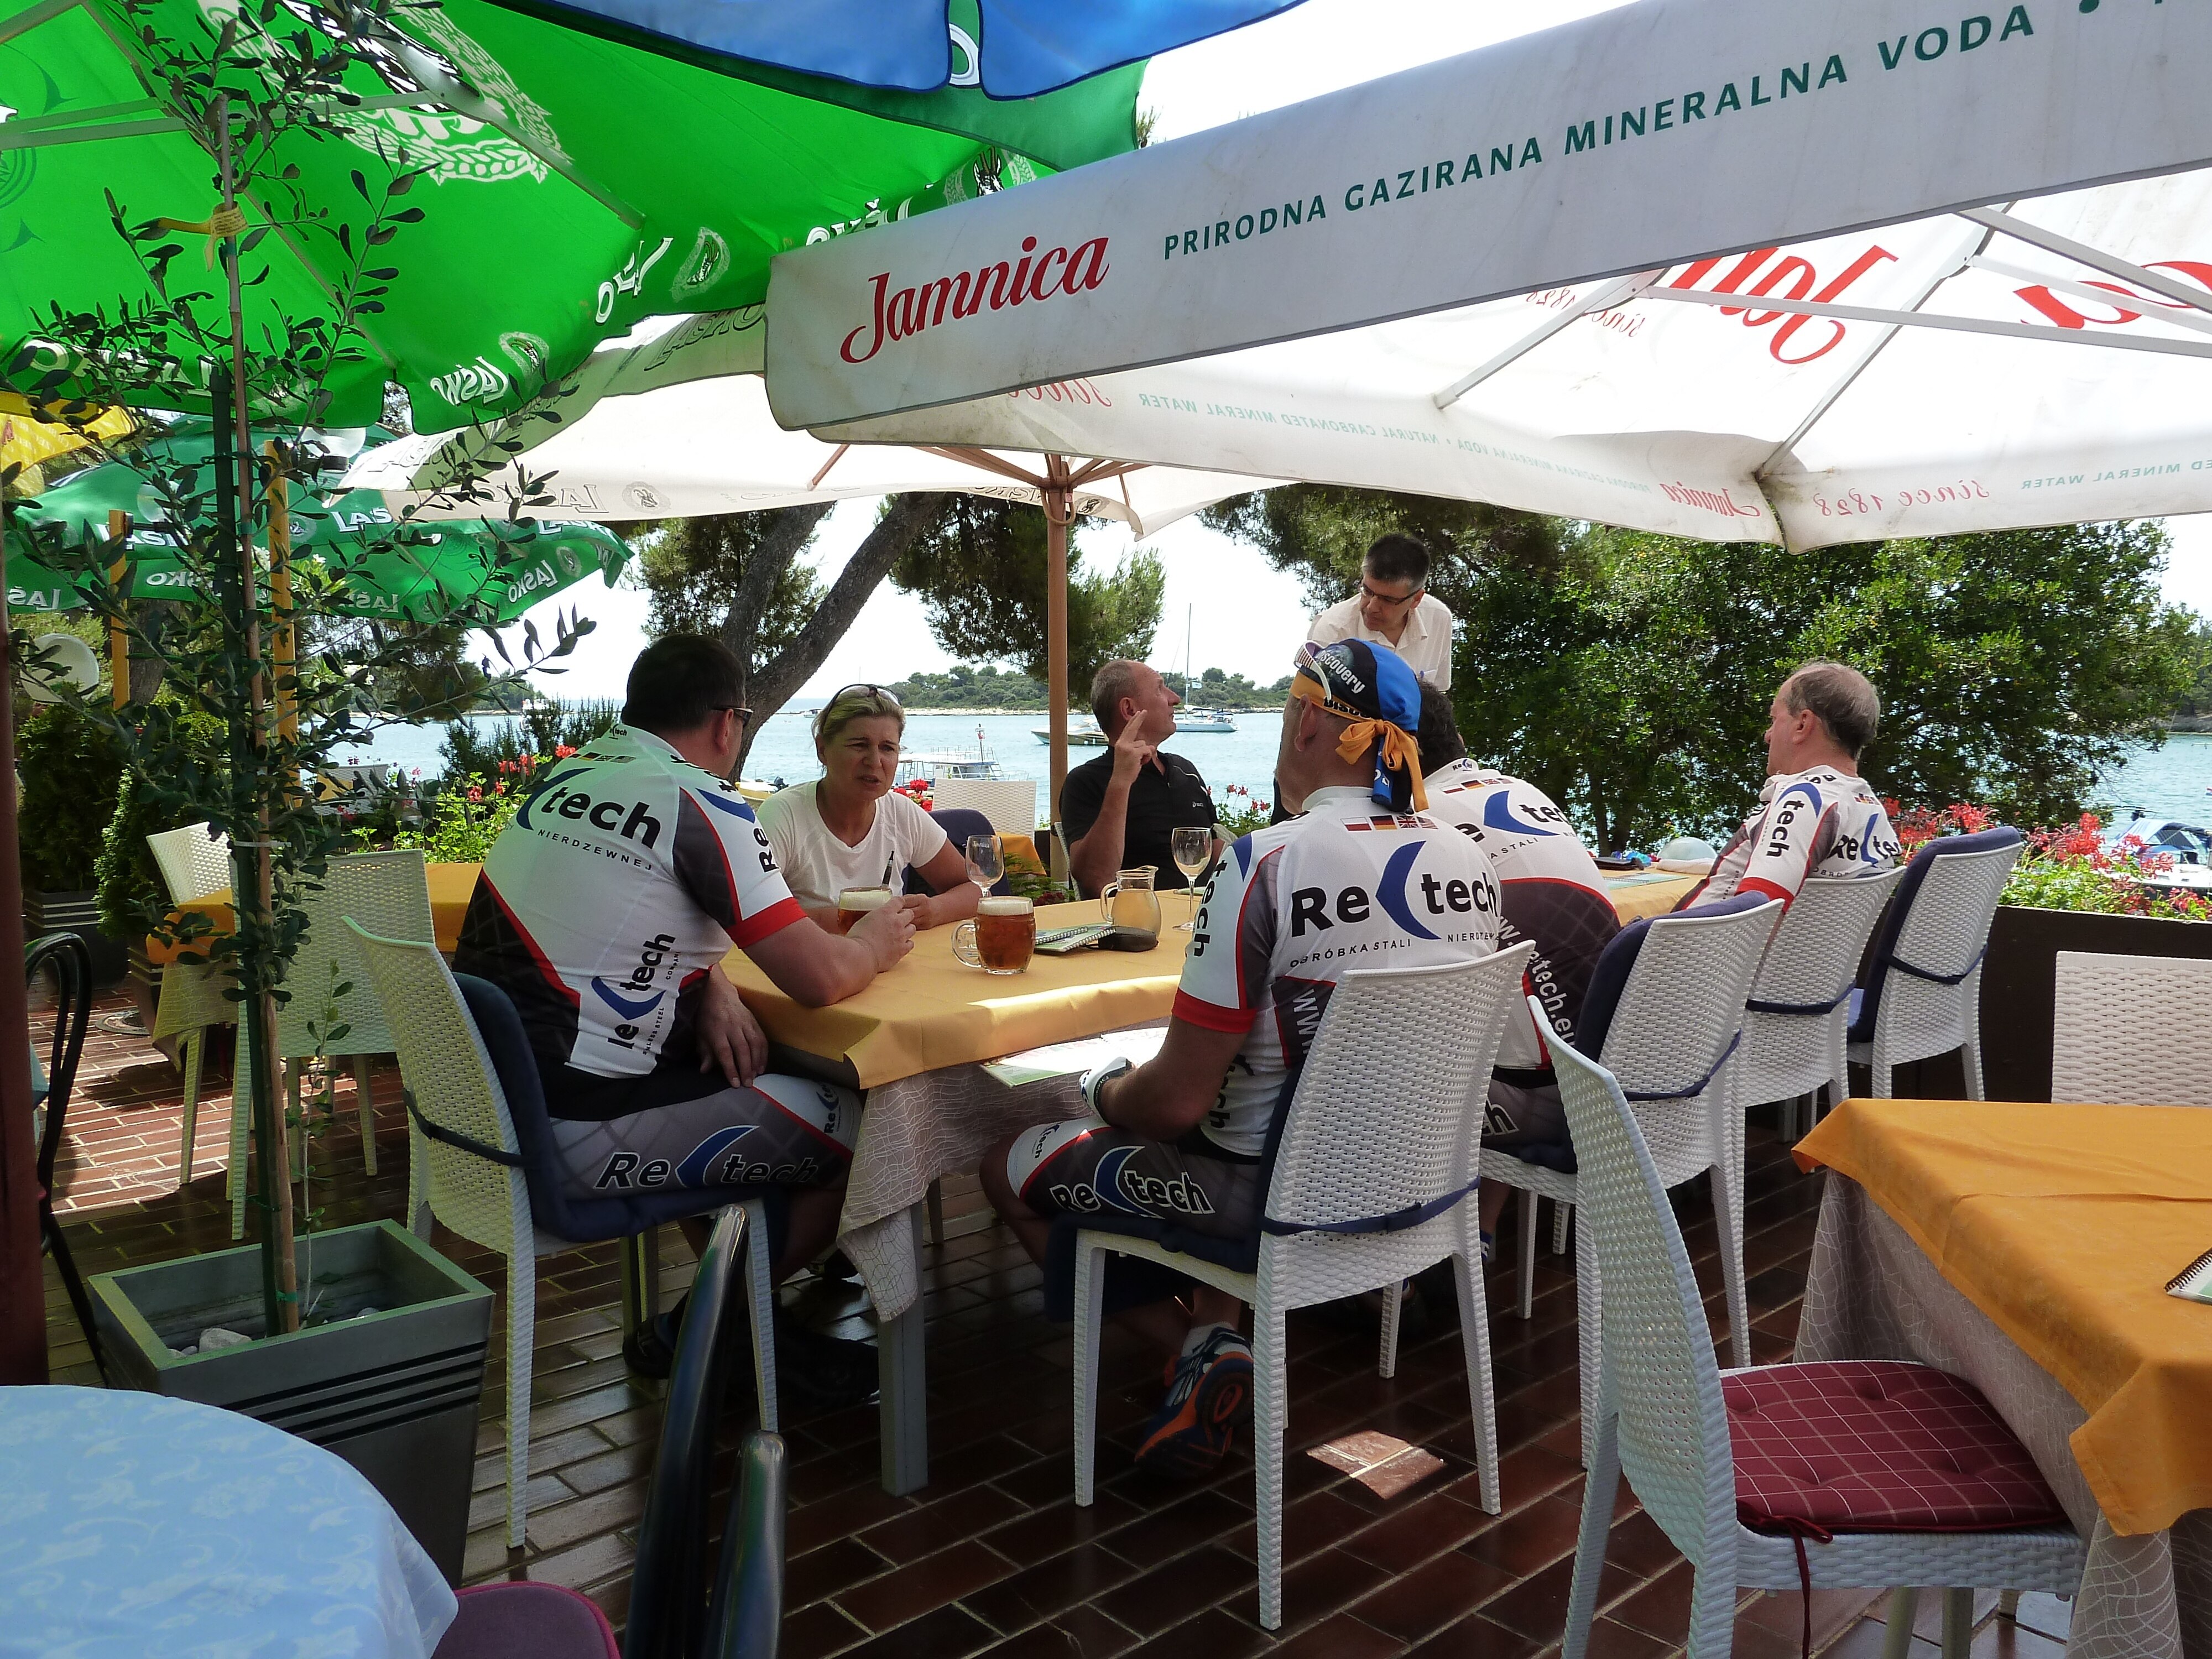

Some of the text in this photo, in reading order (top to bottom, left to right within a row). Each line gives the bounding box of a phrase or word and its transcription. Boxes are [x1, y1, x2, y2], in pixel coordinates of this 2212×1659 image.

[839, 5, 2034, 364] Jamnica PRIRODNA GAZIRANA MINERALNA VODA
[541, 786, 661, 849] tech
[1766, 800, 1804, 859] tech
[537, 829, 653, 870] NIERDZEWNEJ
[1193, 860, 1228, 957] tech
[1290, 872, 1499, 938] Re tech
[619, 933, 676, 992] tech
[593, 1151, 819, 1190] Re tech
[1049, 1170, 1215, 1214] Re tech
